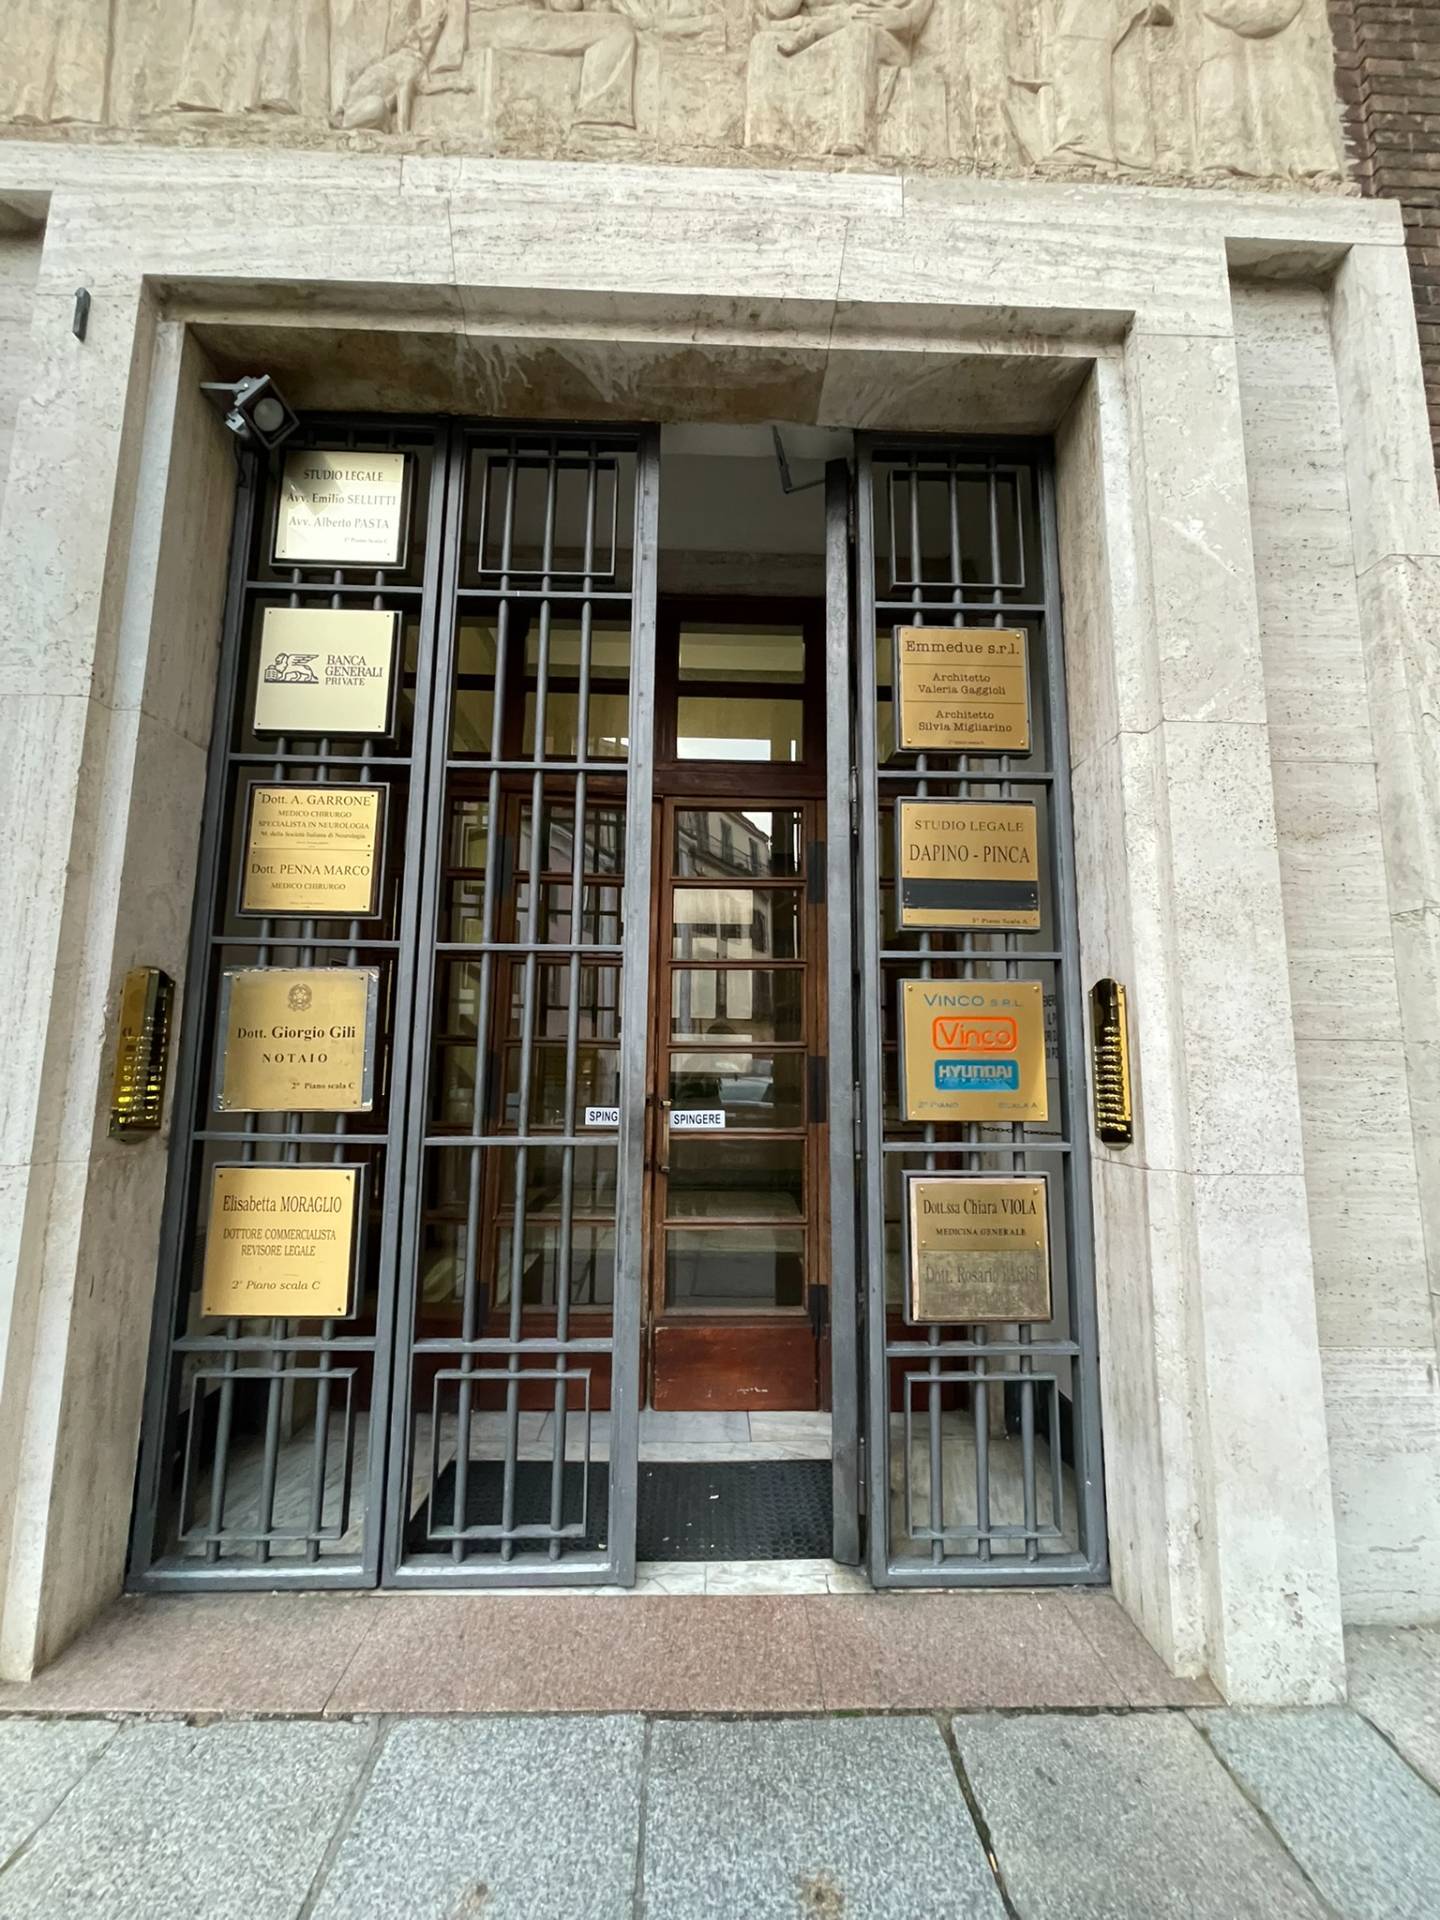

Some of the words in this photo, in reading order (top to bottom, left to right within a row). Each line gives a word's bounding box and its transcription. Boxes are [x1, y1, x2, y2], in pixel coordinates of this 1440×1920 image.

[304, 469, 342, 480] STUDIO
[346, 470, 384, 481] LEGALE
[287, 492, 309, 502] Avv.
[312, 492, 344, 504] Emilio
[347, 494, 396, 505] SELLITTI
[288, 516, 310, 526] Avv.
[314, 517, 351, 528] Alberto
[354, 518, 390, 528] PASTA
[906, 640, 983, 654] Emmedue
[988, 644, 1020, 654] s.r.l.
[327, 654, 366, 666] BANCA
[325, 667, 383, 678] GENERALI
[932, 673, 990, 682] Architetto
[325, 678, 365, 686] PRIVATE
[918, 685, 958, 694] Valeria
[961, 685, 1006, 696] Gaggioli
[936, 710, 994, 720] Architetto
[918, 722, 950, 731] Silvia
[954, 722, 1012, 733] Migliarino
[261, 794, 288, 804] Dott.
[290, 795, 303, 804] A.
[307, 796, 371, 806] GARRONE
[278, 810, 309, 818] MEDICO
[310, 810, 352, 818] CHIRURGO
[258, 820, 306, 828] SPECIALISTA
[318, 822, 370, 830] NEUROLOGIA
[914, 820, 966, 832] STUDIO
[970, 821, 1024, 832] LEGALE
[910, 844, 968, 862] DAPINO
[984, 846, 1030, 864] PINCA
[252, 864, 274, 874] Dott.
[280, 864, 320, 876] PENNA
[324, 865, 370, 876] MARCO
[272, 882, 302, 890] MEDICO
[924, 993, 984, 1006] VINCO
[238, 1028, 266, 1039] Dott.
[272, 1026, 324, 1041] Giorgio
[330, 1026, 356, 1038] Gili
[938, 1022, 1012, 1046] Vinco
[262, 1053, 328, 1064] NOTAIO
[938, 1066, 1012, 1078] HYUNDAI
[304, 1082, 326, 1090] Piano
[328, 1082, 348, 1090] scala
[348, 1082, 356, 1090] C
[590, 1110, 618, 1122] SPING
[674, 1114, 721, 1124] SPINGERE
[223, 1195, 276, 1212] Elisabetta
[280, 1196, 342, 1214] MORAGLIO
[923, 1199, 960, 1214] Dott.ssa
[964, 1198, 998, 1215] Chiara
[1001, 1200, 1036, 1215] VIOLA
[223, 1228, 262, 1240] DOTTORE
[265, 1228, 336, 1240] COMMERCIALISTA
[936, 1228, 977, 1236] MEDICINA
[980, 1228, 1026, 1236] GENERALE
[241, 1245, 282, 1256] REVISORE
[284, 1245, 316, 1256] LEGALE
[246, 1280, 276, 1290] Piano
[280, 1280, 308, 1290] scala
[312, 1281, 320, 1290] C
